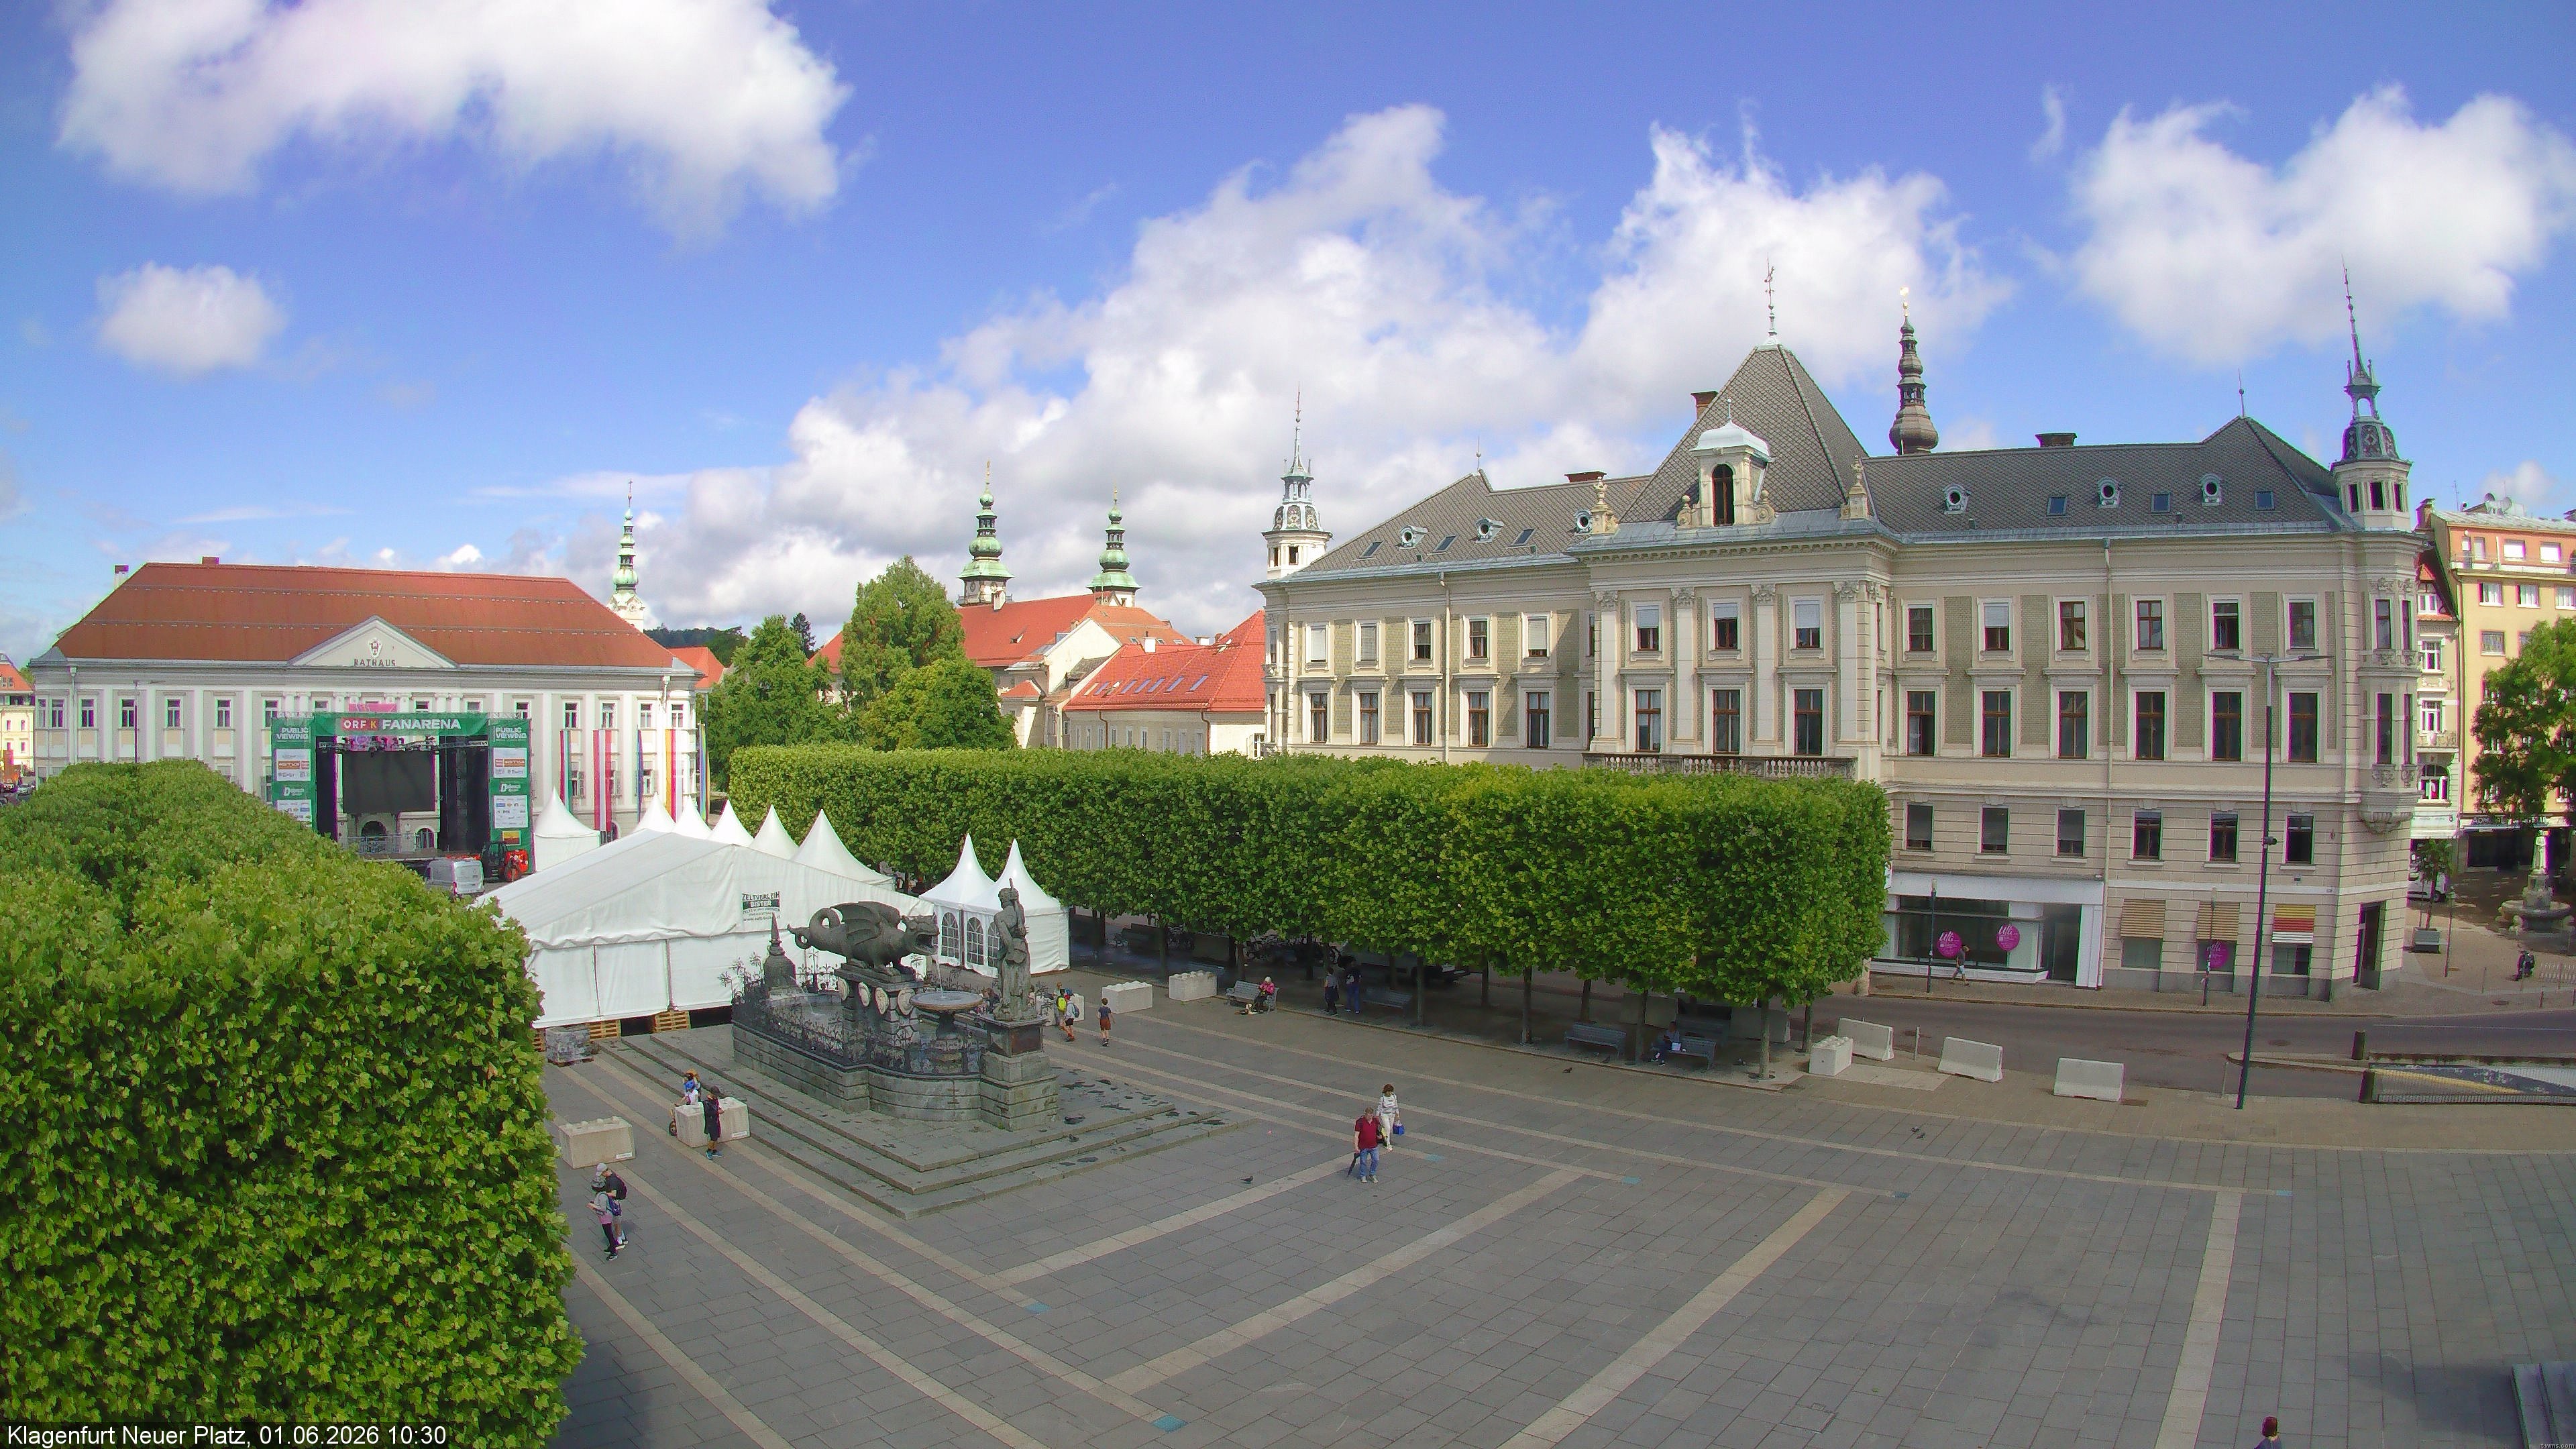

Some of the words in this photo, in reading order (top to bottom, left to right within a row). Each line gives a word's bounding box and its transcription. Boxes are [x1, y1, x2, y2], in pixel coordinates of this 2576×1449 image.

[354, 659, 396, 667] RATHAUS
[343, 720, 367, 729] ORF
[370, 720, 378, 729] K
[382, 719, 462, 730] FANARENA
[742, 892, 780, 901] ZELTVERLEIH
